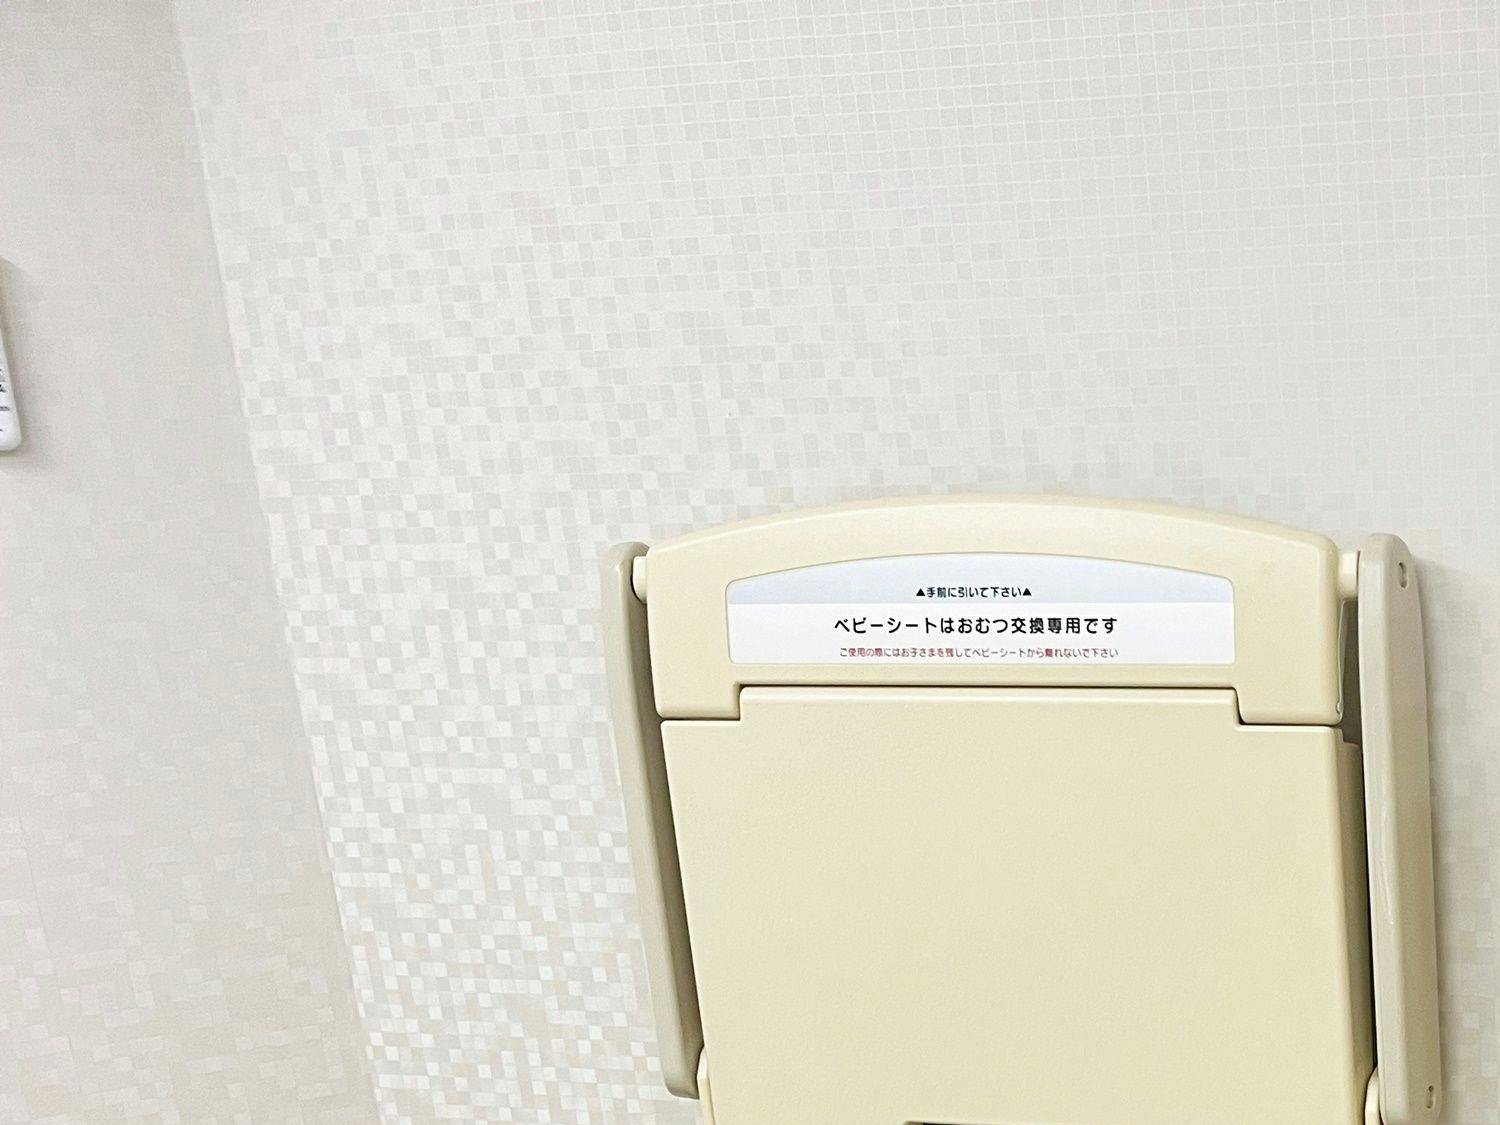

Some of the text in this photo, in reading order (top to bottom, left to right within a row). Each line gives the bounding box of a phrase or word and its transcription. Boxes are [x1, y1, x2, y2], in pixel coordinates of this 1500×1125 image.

[834, 616, 1118, 634] ベビーシートはおむつ交換専用です
[839, 647, 1119, 658] ご使用の際にはお子さまを残してベビーシートから離れないで下さい
